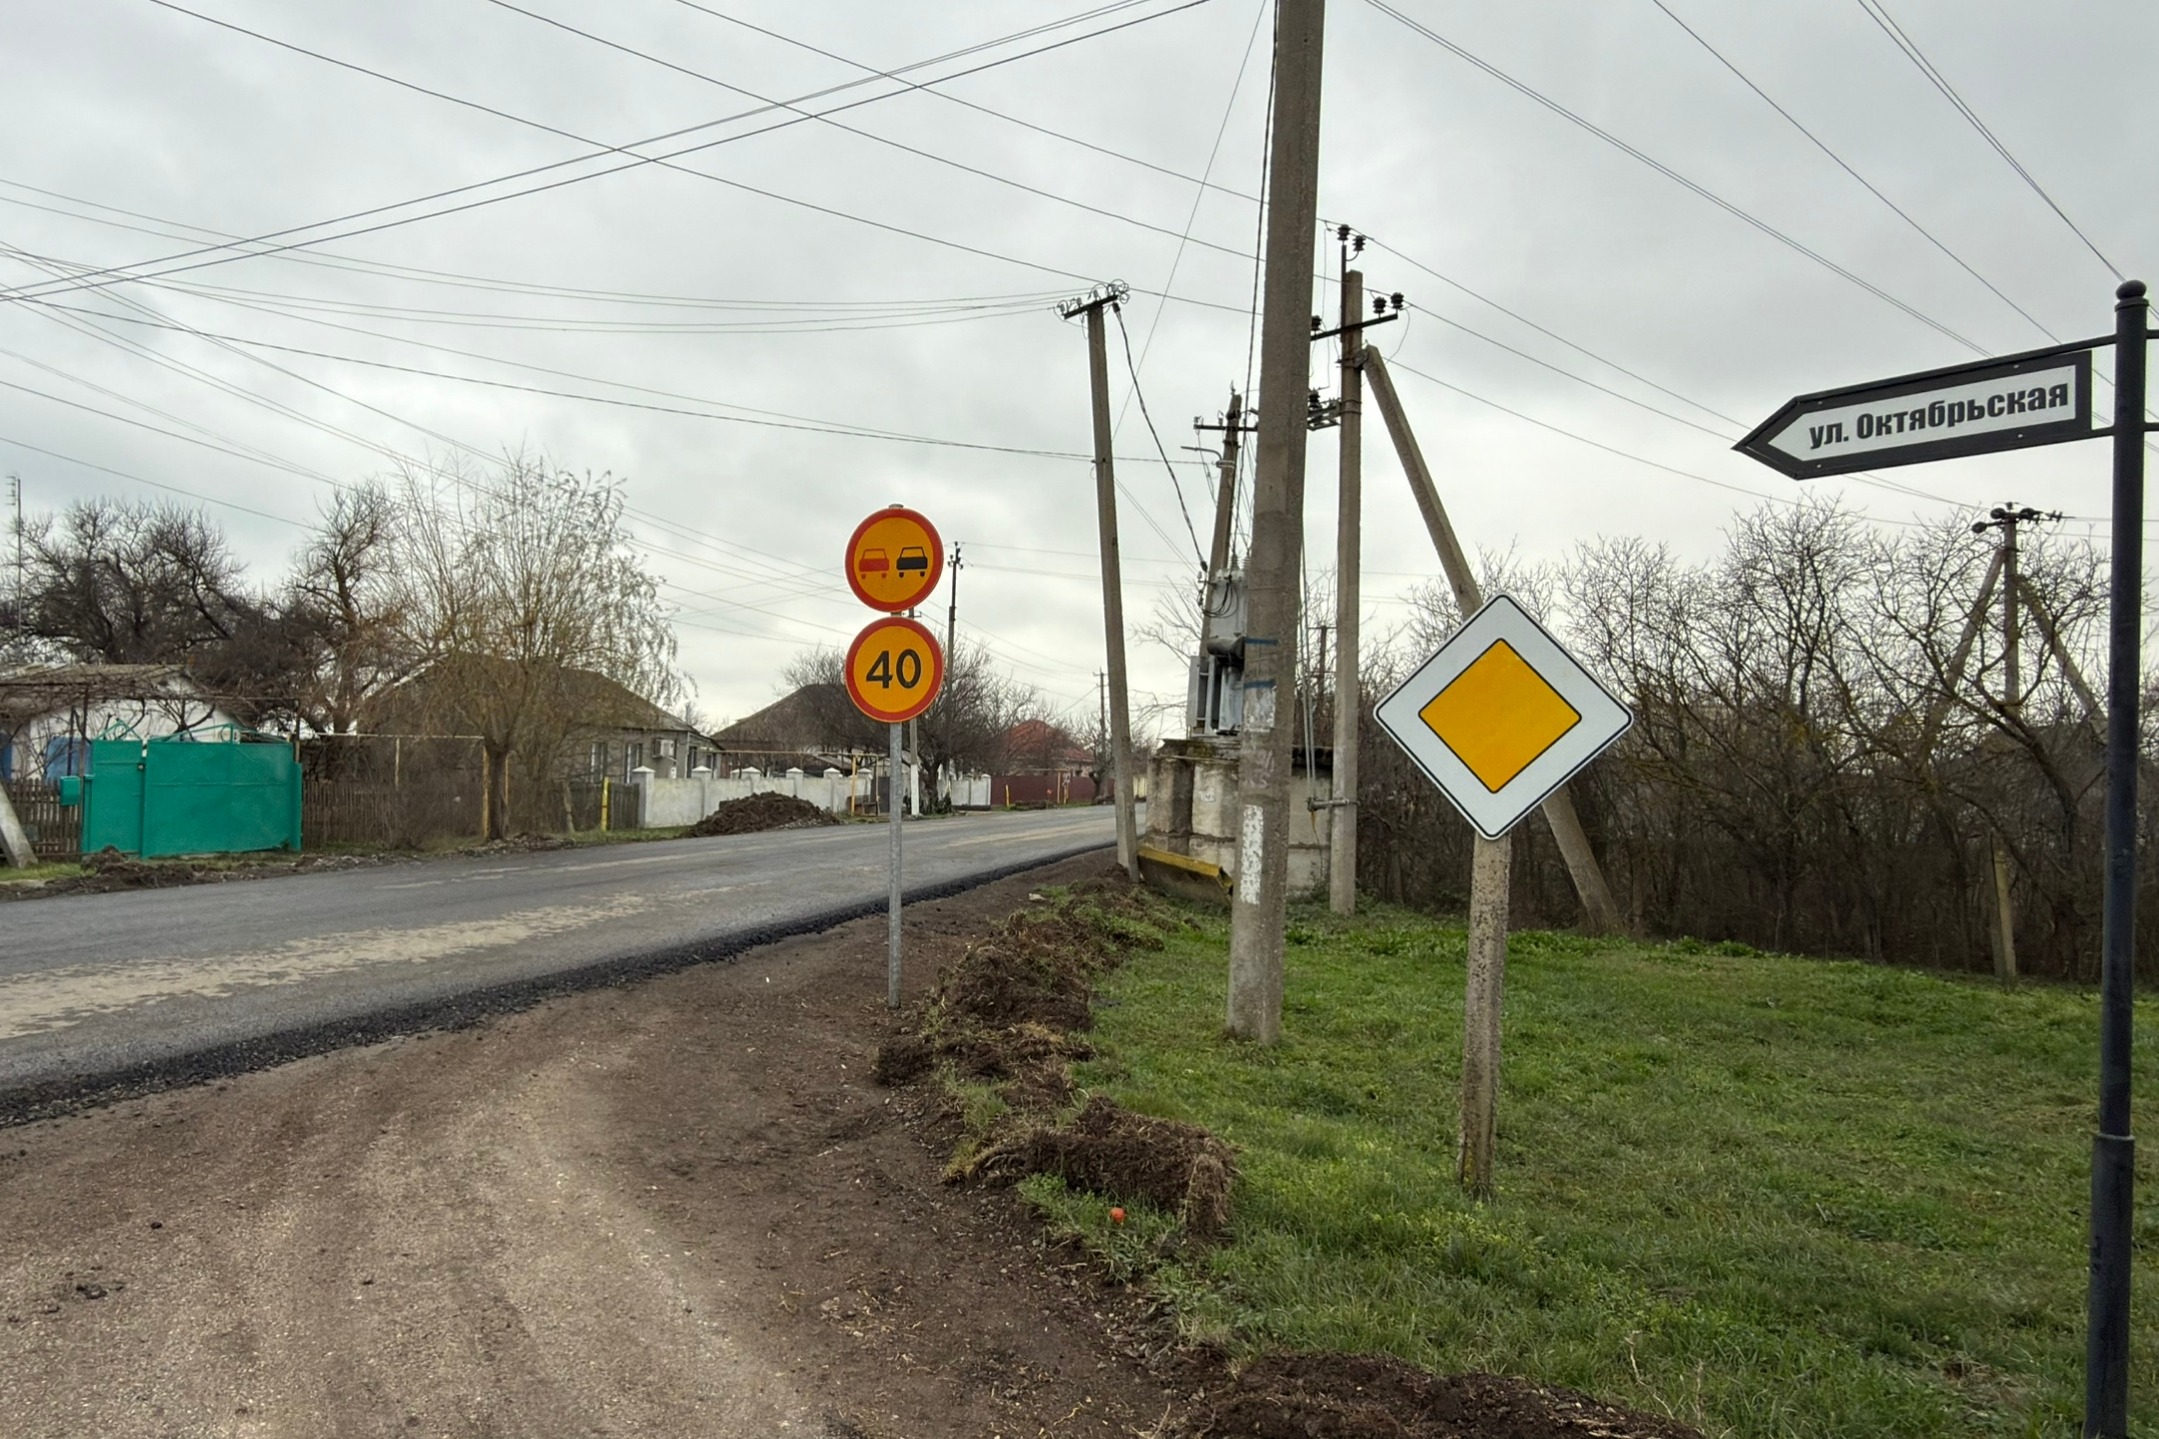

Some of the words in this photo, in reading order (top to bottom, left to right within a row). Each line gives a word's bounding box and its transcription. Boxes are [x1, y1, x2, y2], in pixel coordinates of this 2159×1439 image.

[1809, 422, 1850, 450] ул.
[1856, 382, 2069, 440] Октябрьская
[865, 648, 922, 689] 40
